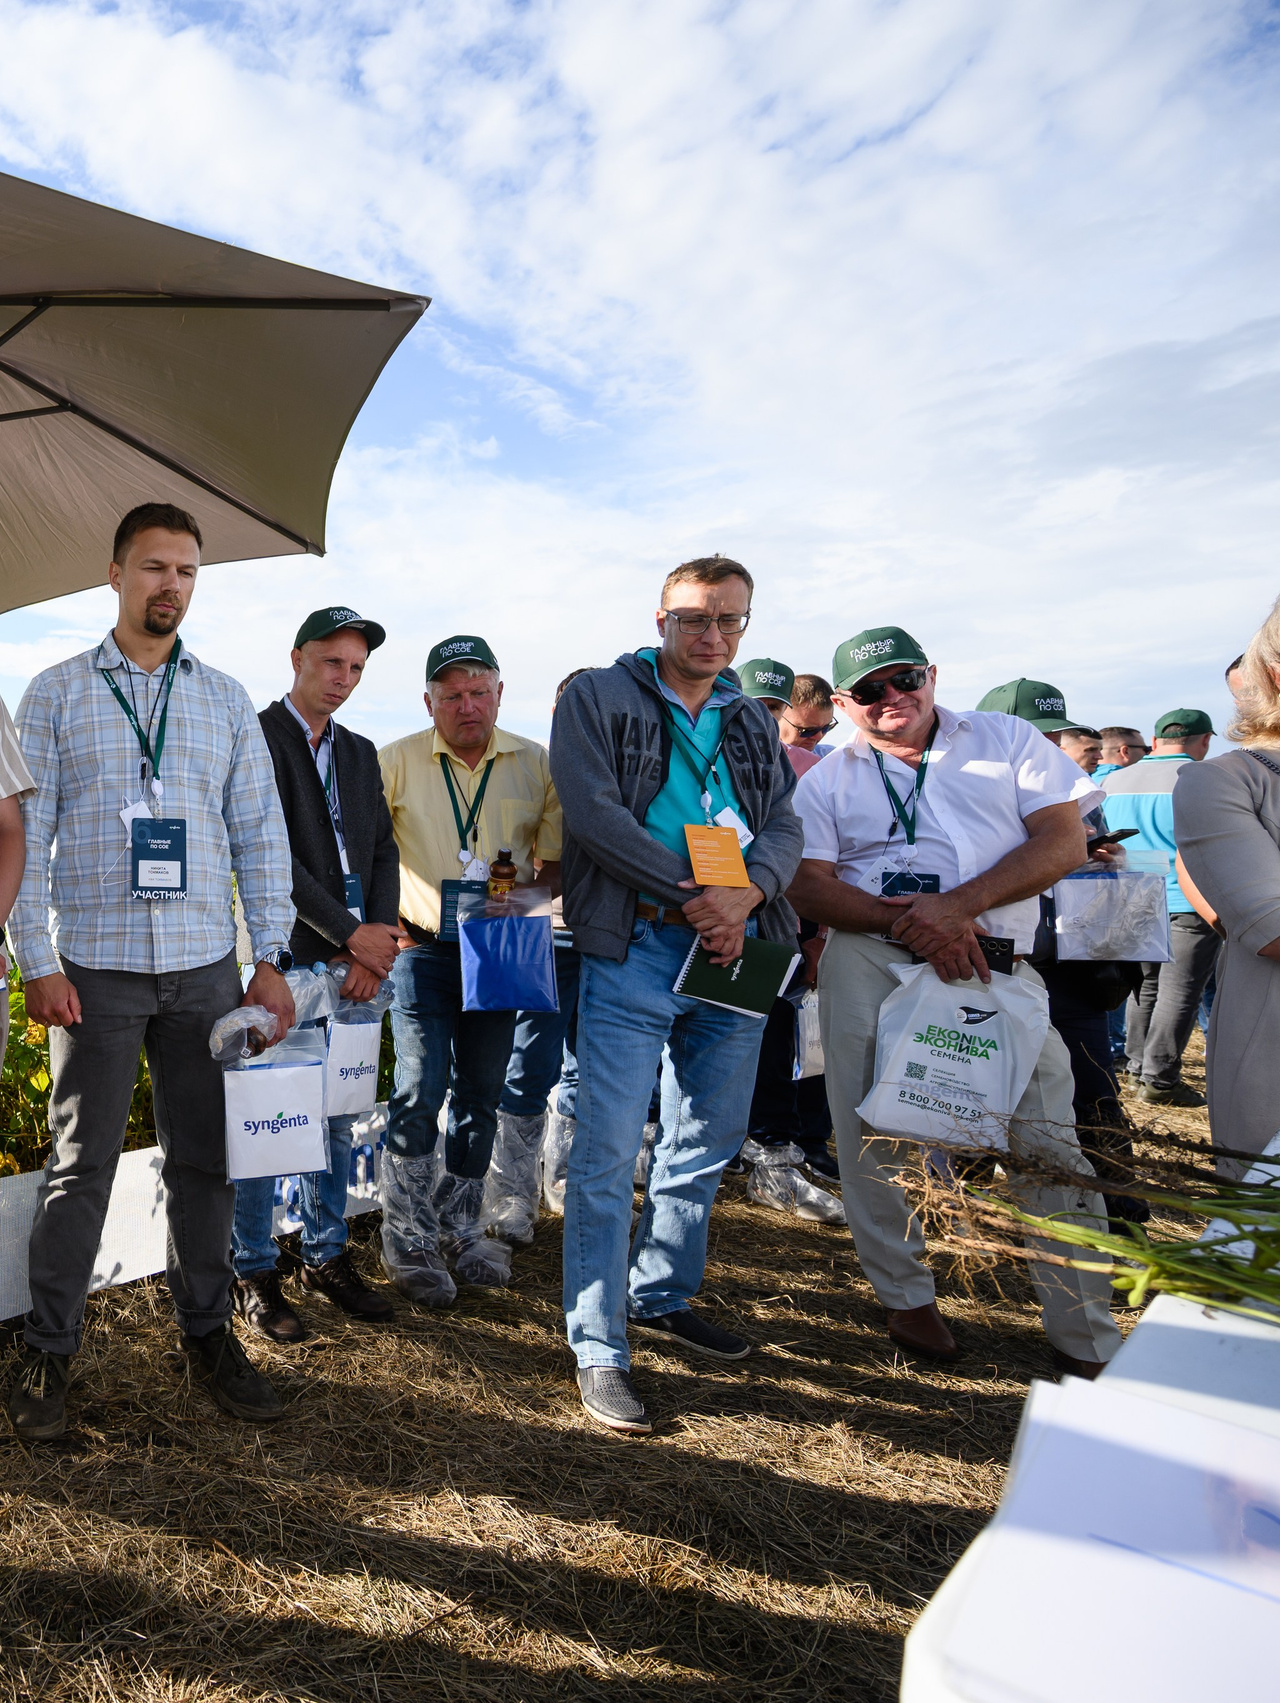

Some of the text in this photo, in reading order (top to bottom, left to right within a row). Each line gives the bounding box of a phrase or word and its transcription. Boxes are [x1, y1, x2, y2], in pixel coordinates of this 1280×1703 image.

[854, 645, 892, 662] ПО СОЕ
[131, 890, 188, 900] УЧАСТНИК
[912, 1032, 991, 1061] ЭКОНИВА
[926, 1024, 999, 1052] EKONIVA
[930, 1049, 972, 1066] СЕМЕНА
[339, 1061, 376, 1080] syngenta
[899, 1090, 906, 1098] 8
[908, 1092, 930, 1105] 800
[932, 1098, 952, 1110] 700
[954, 1104, 968, 1115] 97
[243, 1112, 309, 1136] syngenta
